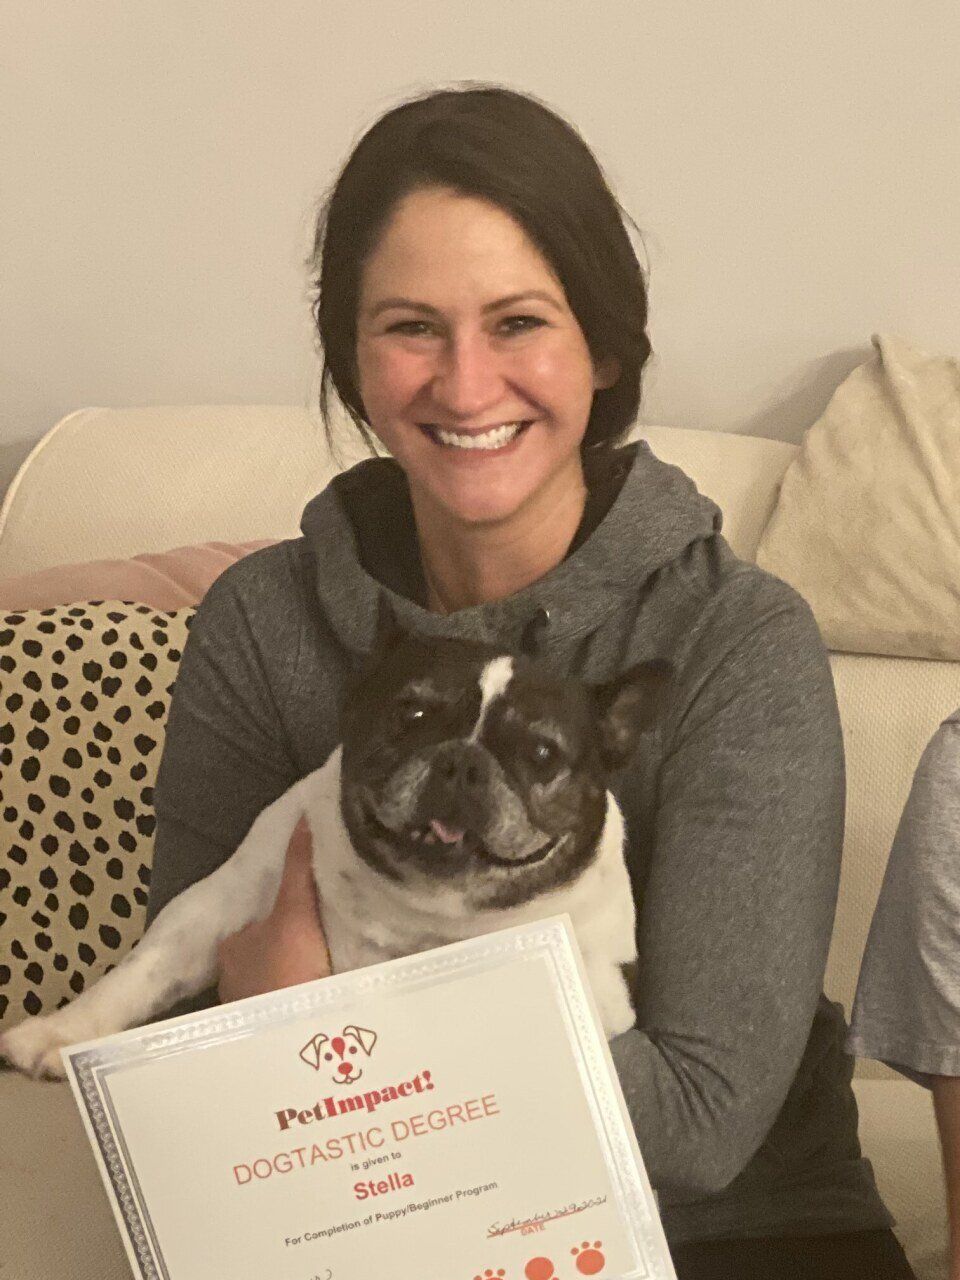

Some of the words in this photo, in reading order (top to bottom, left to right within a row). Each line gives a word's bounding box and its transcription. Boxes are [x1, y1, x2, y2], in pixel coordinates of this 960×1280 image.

[274, 1070, 436, 1131] PetImpact!
[233, 1127, 386, 1186] DOGTASTIC
[391, 1094, 501, 1142] DEGREE
[350, 1162, 361, 1172] is
[362, 1155, 390, 1171] given
[391, 1151, 402, 1160] to
[284, 1235, 302, 1248] For
[304, 1221, 362, 1242] Completion
[363, 1214, 374, 1226] of
[375, 1194, 455, 1223] Puppy/Beginner
[455, 1181, 499, 1204] Program
[353, 1171, 415, 1201] Stella
